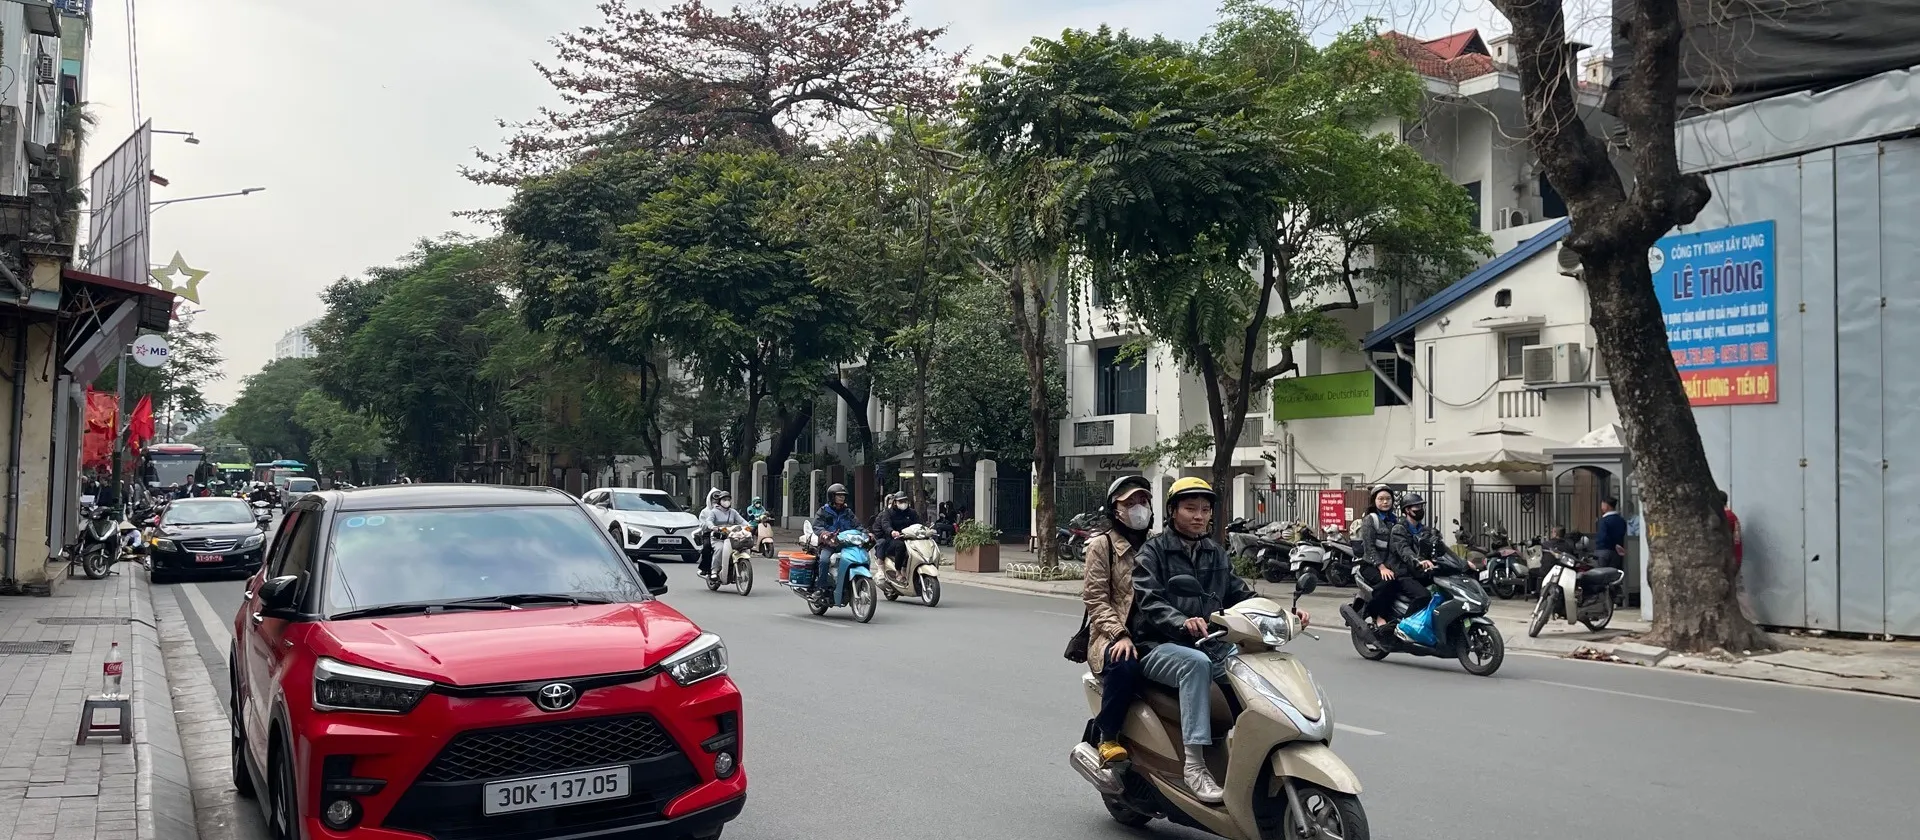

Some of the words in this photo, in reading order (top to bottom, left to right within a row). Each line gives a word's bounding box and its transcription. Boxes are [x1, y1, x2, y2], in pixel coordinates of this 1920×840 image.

[1671, 244, 1692, 260] CÔNG
[1693, 243, 1703, 256] TY
[1703, 240, 1724, 255] TNHH
[1725, 235, 1740, 252] XÂY
[1742, 233, 1765, 251] DỰNG
[1673, 263, 1694, 301] LÊ
[1698, 257, 1764, 297] THÔNG
[150, 347, 167, 356] MB
[1702, 376, 1730, 402] LƯỢNG
[1736, 370, 1755, 396] TIẾN
[498, 773, 618, 807] 30K-137.05
